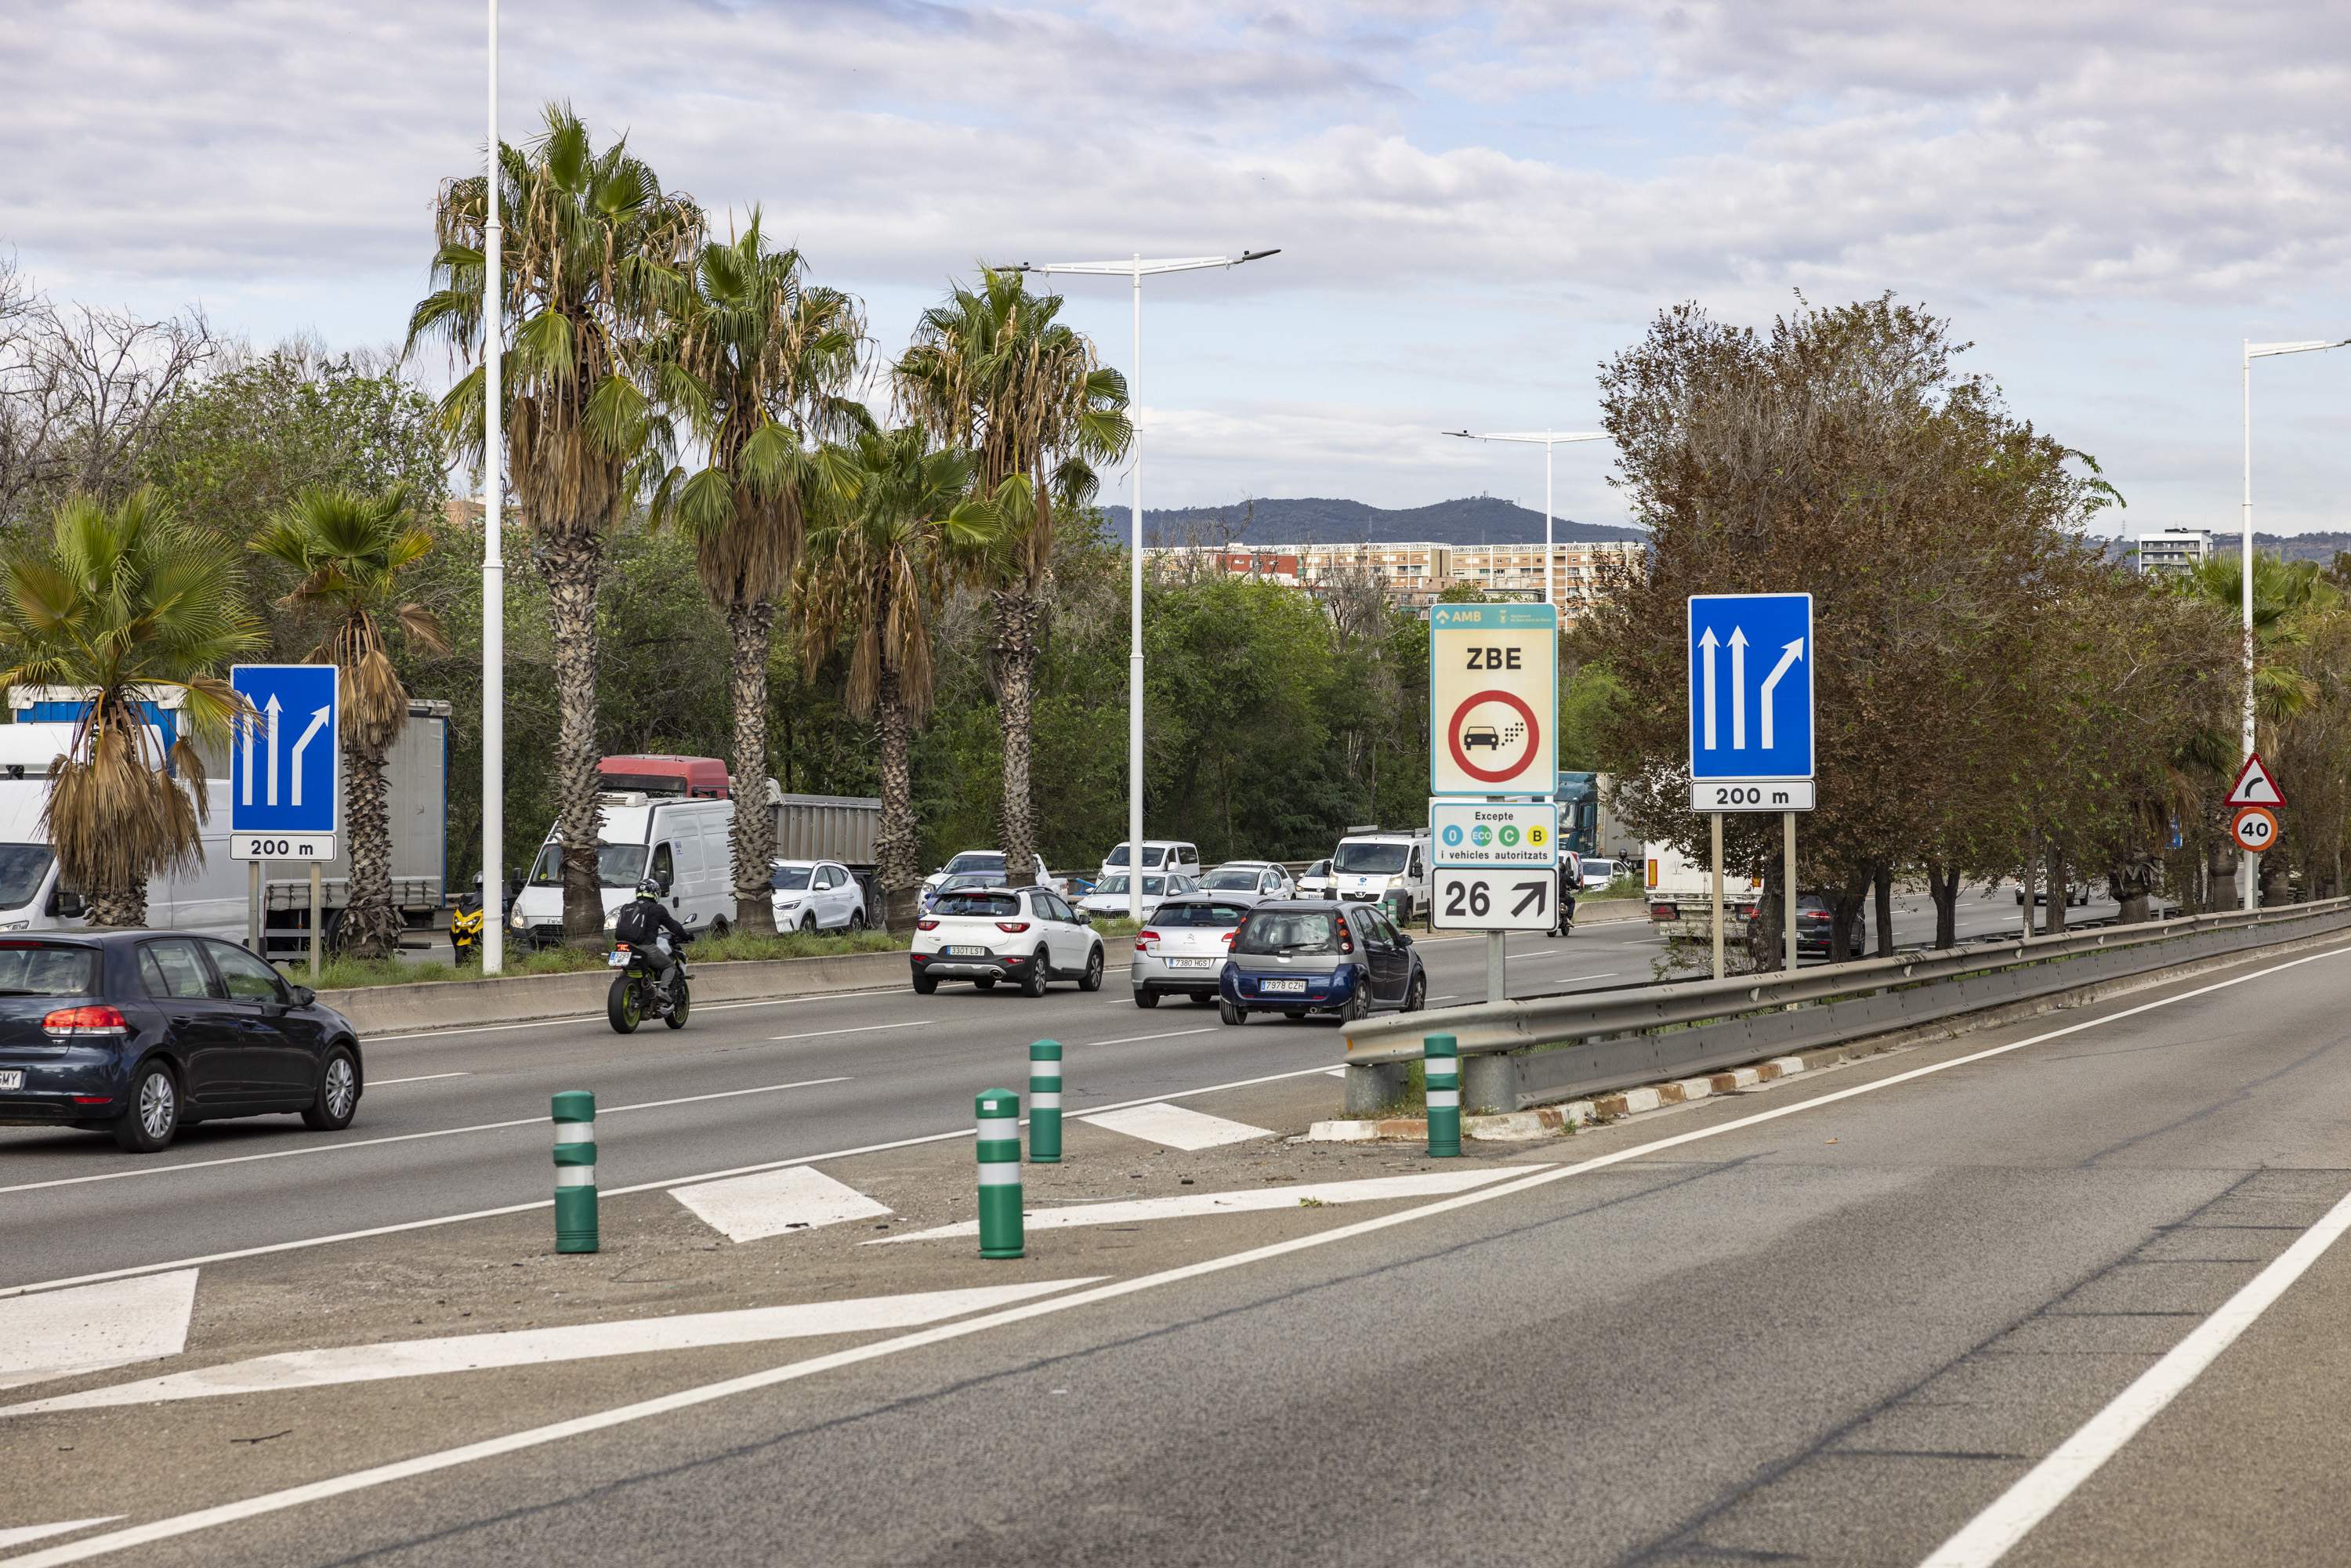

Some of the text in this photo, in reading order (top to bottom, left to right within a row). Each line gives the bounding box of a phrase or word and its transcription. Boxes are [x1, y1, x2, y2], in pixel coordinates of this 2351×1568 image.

[1451, 611, 1481, 622] AMB
[1466, 647, 1521, 670] ZBE
[1716, 788, 1789, 805] 200 m
[1475, 811, 1514, 822] Excepte
[1448, 830, 1542, 842] 0 ECO C B
[2241, 822, 2269, 838] 40
[251, 839, 313, 855] 200 m
[1441, 850, 1548, 860] i vehicles autoritzats
[1445, 881, 1490, 917] 26
[0, 1072, 17, 1086] MY
